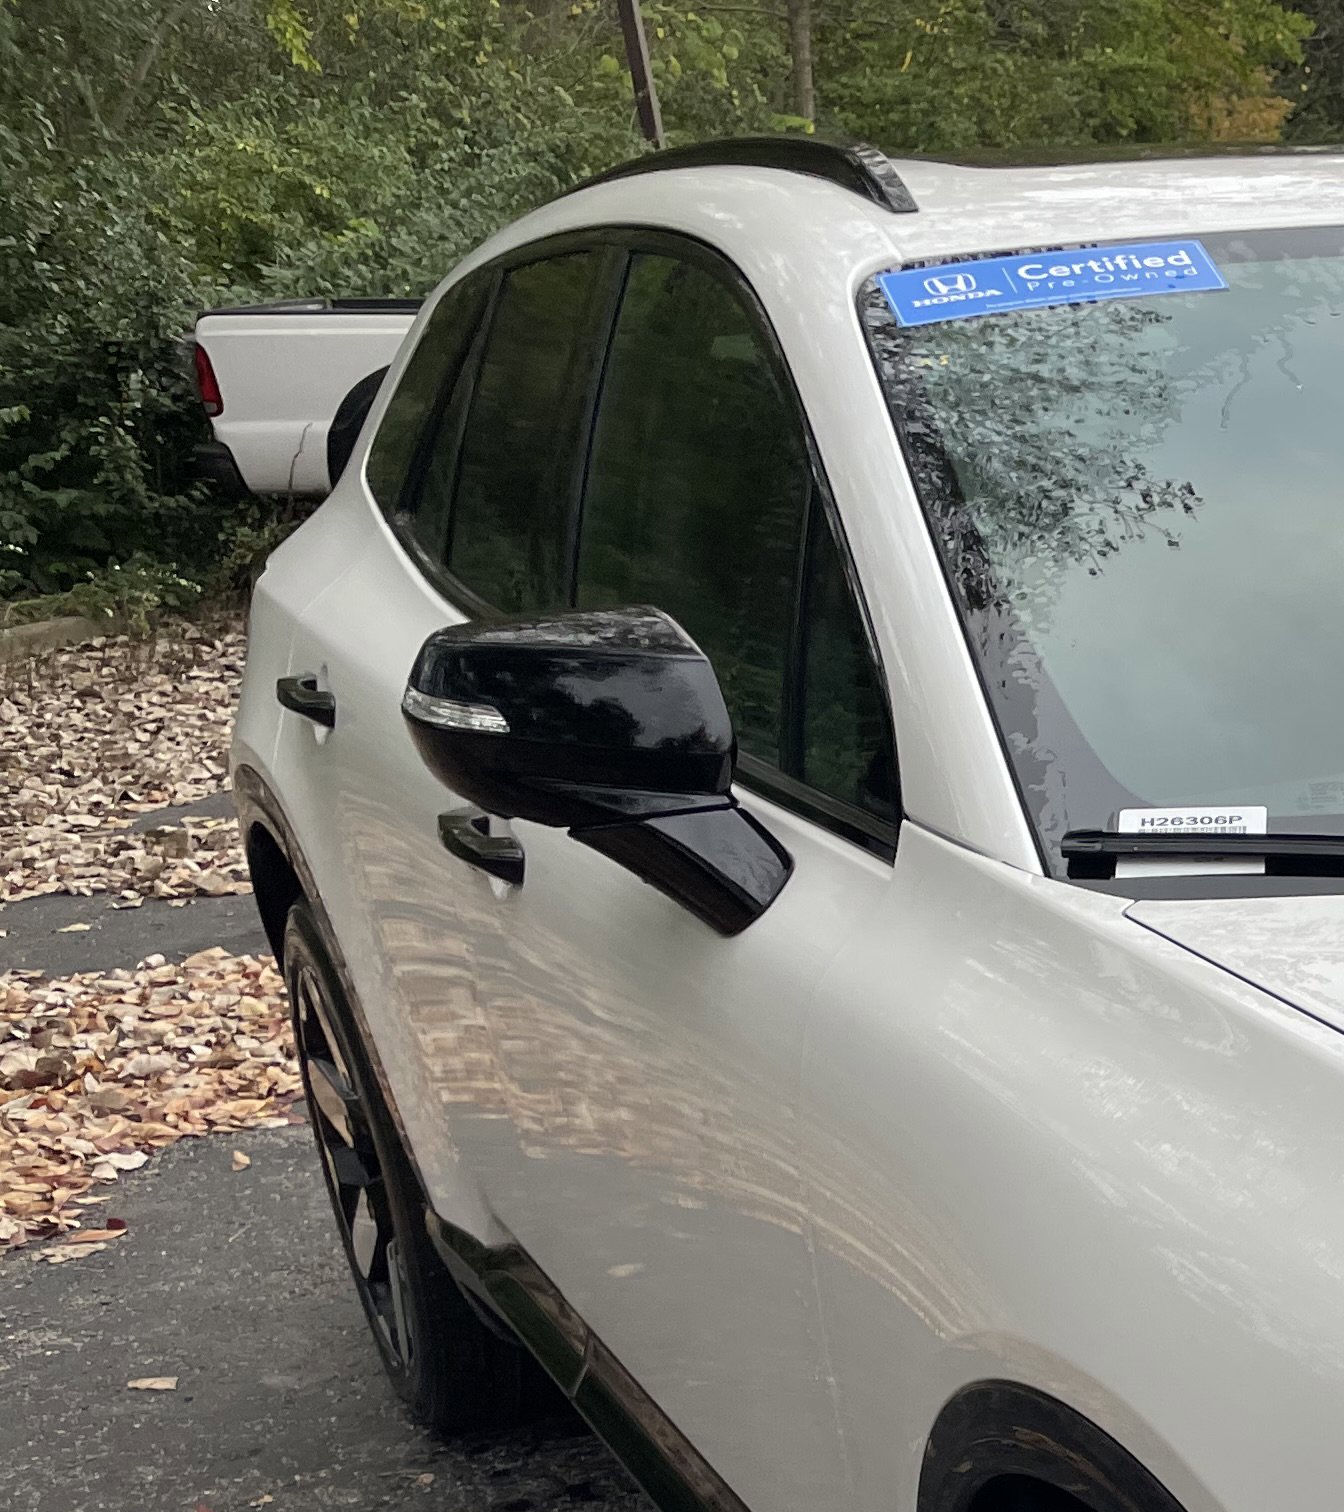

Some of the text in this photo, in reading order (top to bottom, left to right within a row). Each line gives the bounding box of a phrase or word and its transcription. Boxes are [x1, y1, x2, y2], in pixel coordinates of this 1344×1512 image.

[1017, 250, 1193, 279] Certified
[1027, 266, 1198, 291] Pre-Owned
[912, 289, 1003, 308] HONDA
[1141, 815, 1243, 827] H26306P
